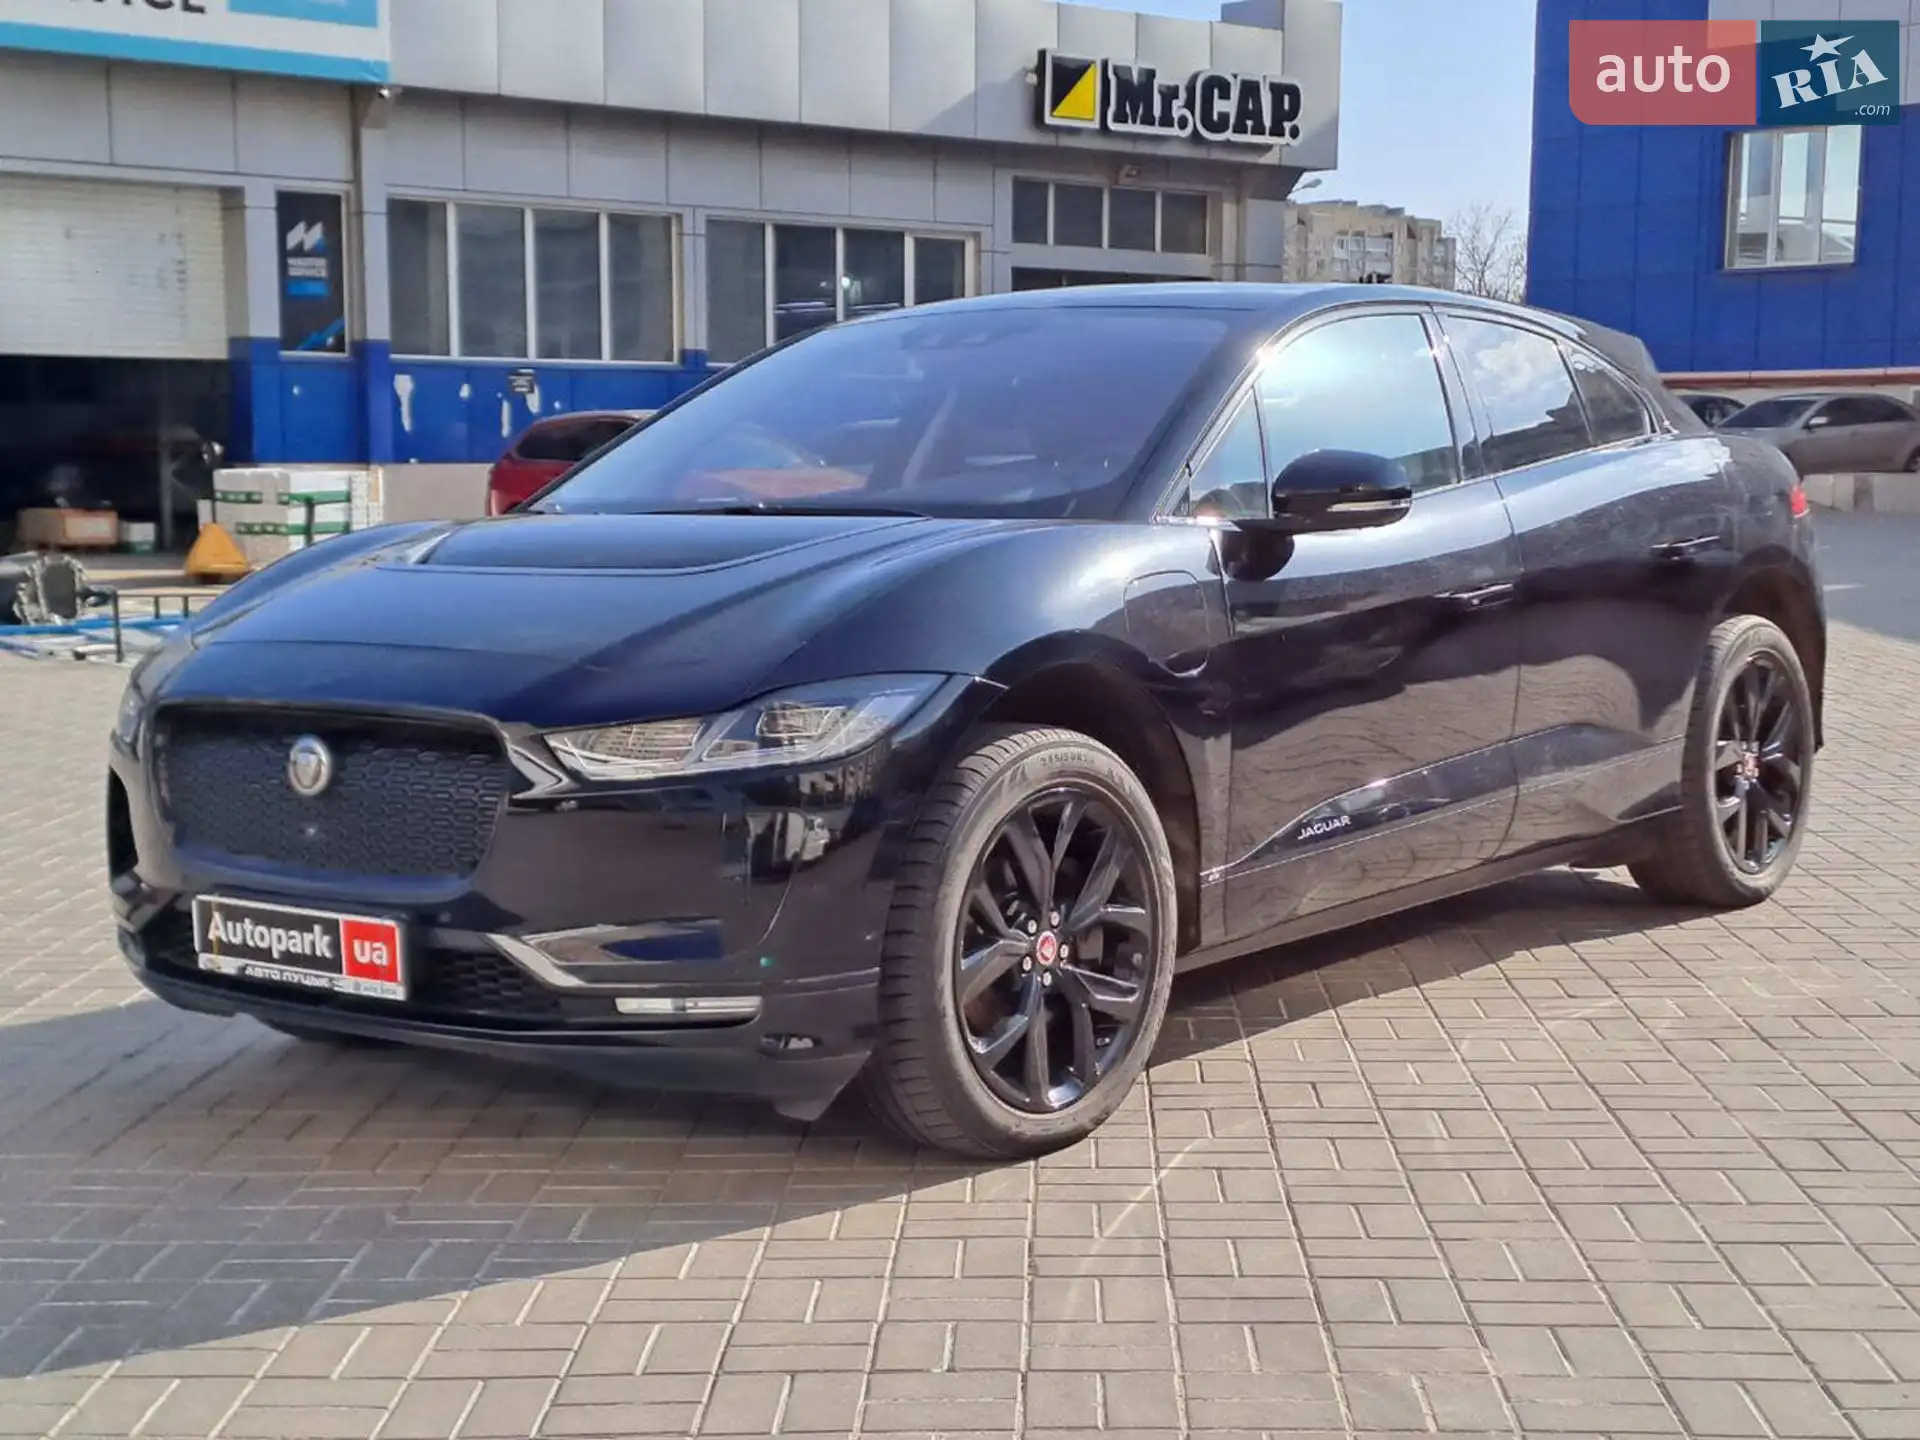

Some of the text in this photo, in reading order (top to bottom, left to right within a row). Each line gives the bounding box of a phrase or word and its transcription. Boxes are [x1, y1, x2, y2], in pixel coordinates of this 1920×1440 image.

[1297, 815, 1352, 840] JAGUAR
[208, 910, 389, 967] Autopark ua
